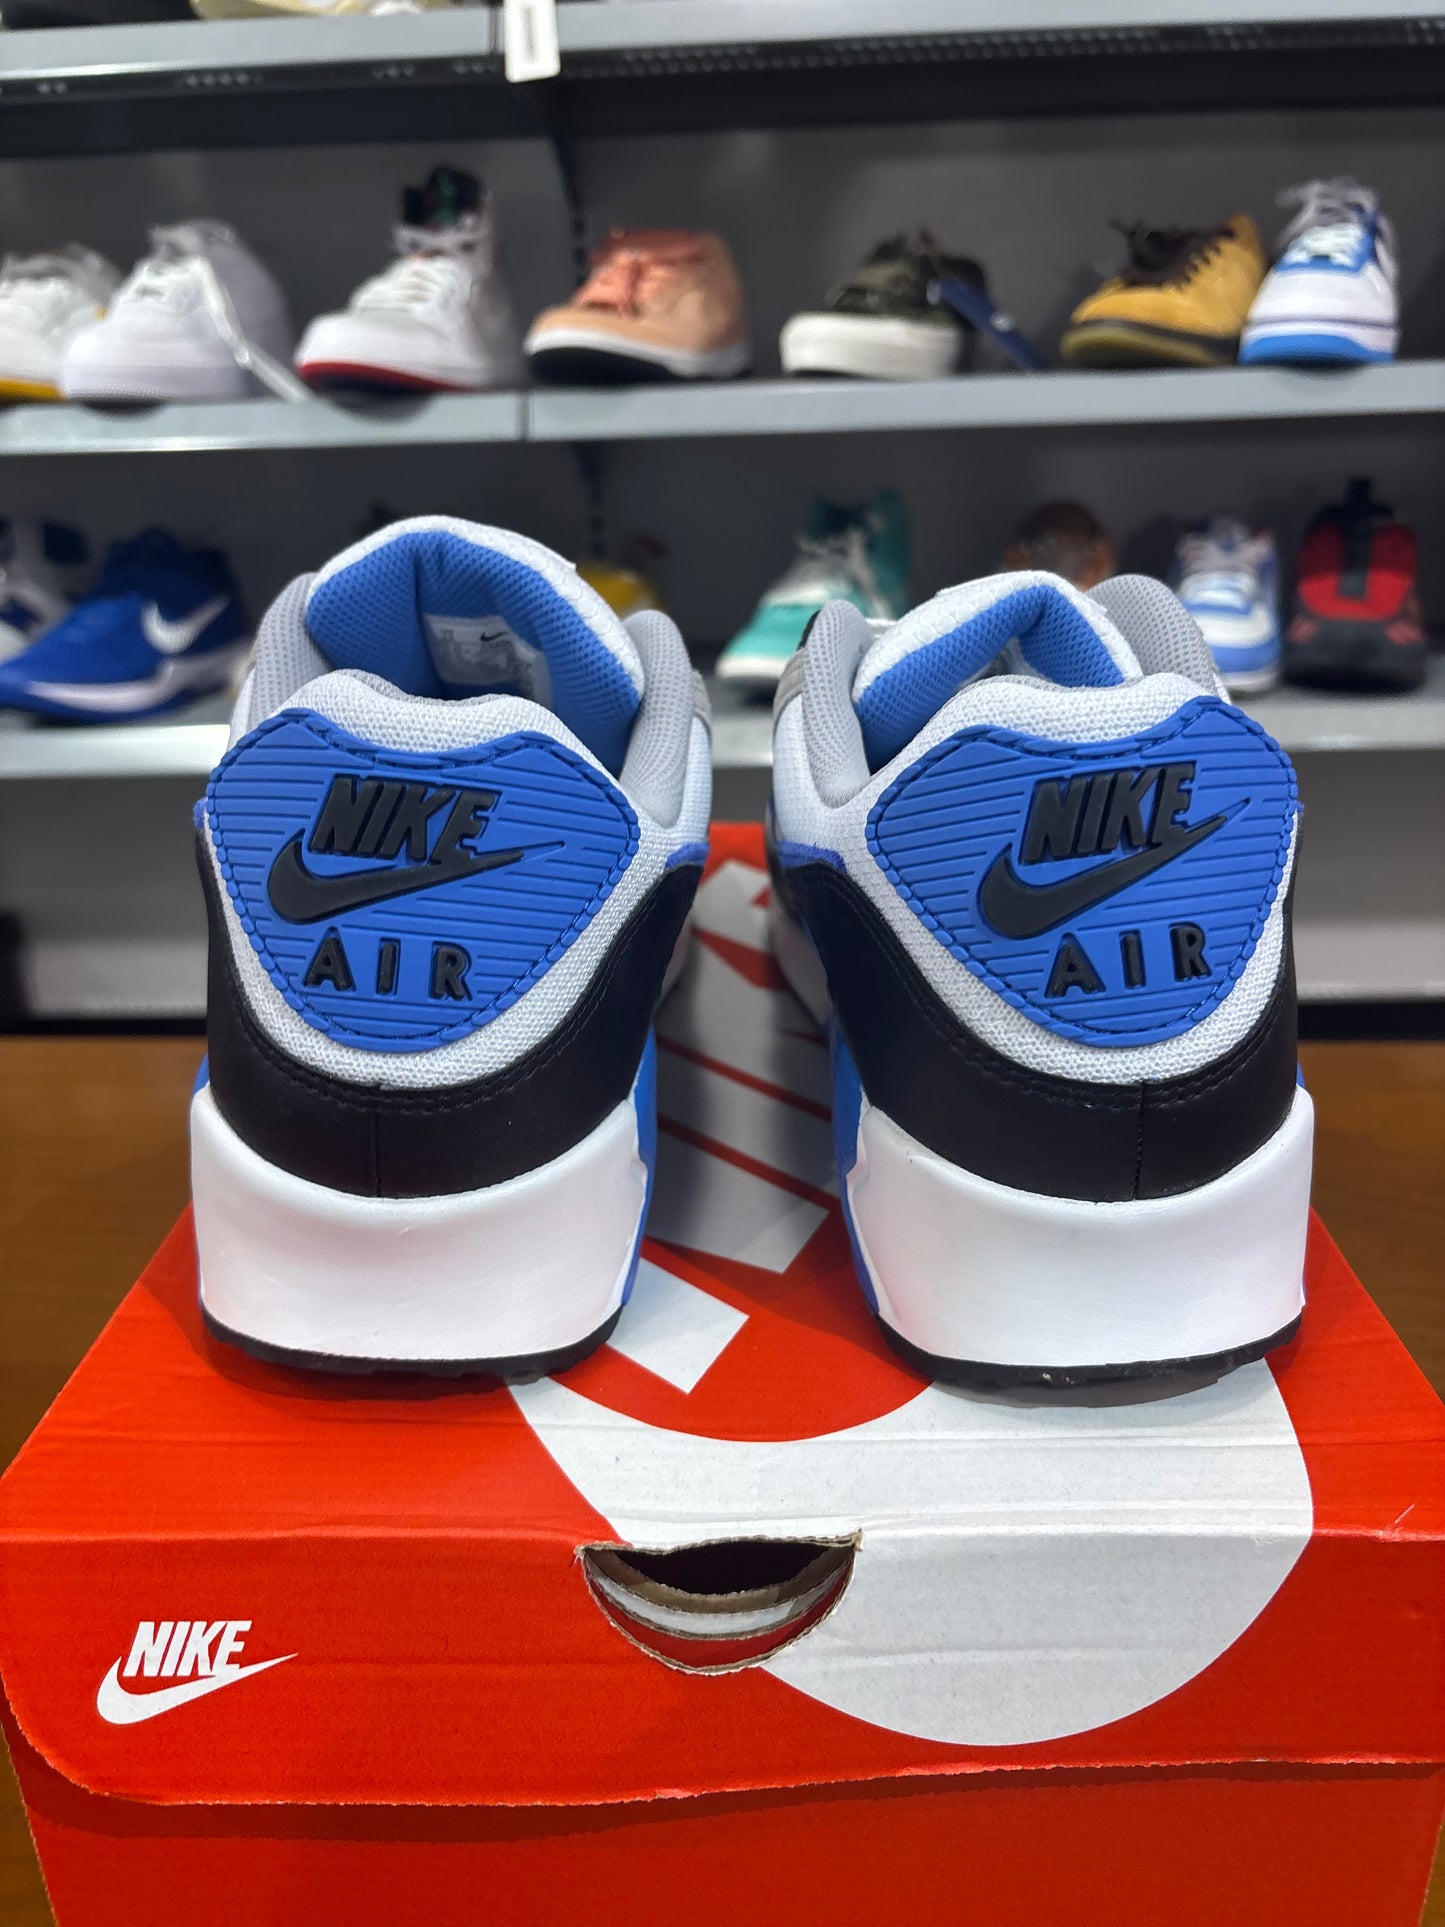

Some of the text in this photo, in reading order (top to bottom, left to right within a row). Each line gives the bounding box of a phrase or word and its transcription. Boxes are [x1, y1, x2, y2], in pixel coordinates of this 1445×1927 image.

[309, 775, 500, 864] NIKE
[1019, 763, 1196, 864] NIKE
[304, 934, 472, 1001] AIR
[1044, 923, 1211, 998] AIR
[123, 1620, 252, 1677] NIKE
